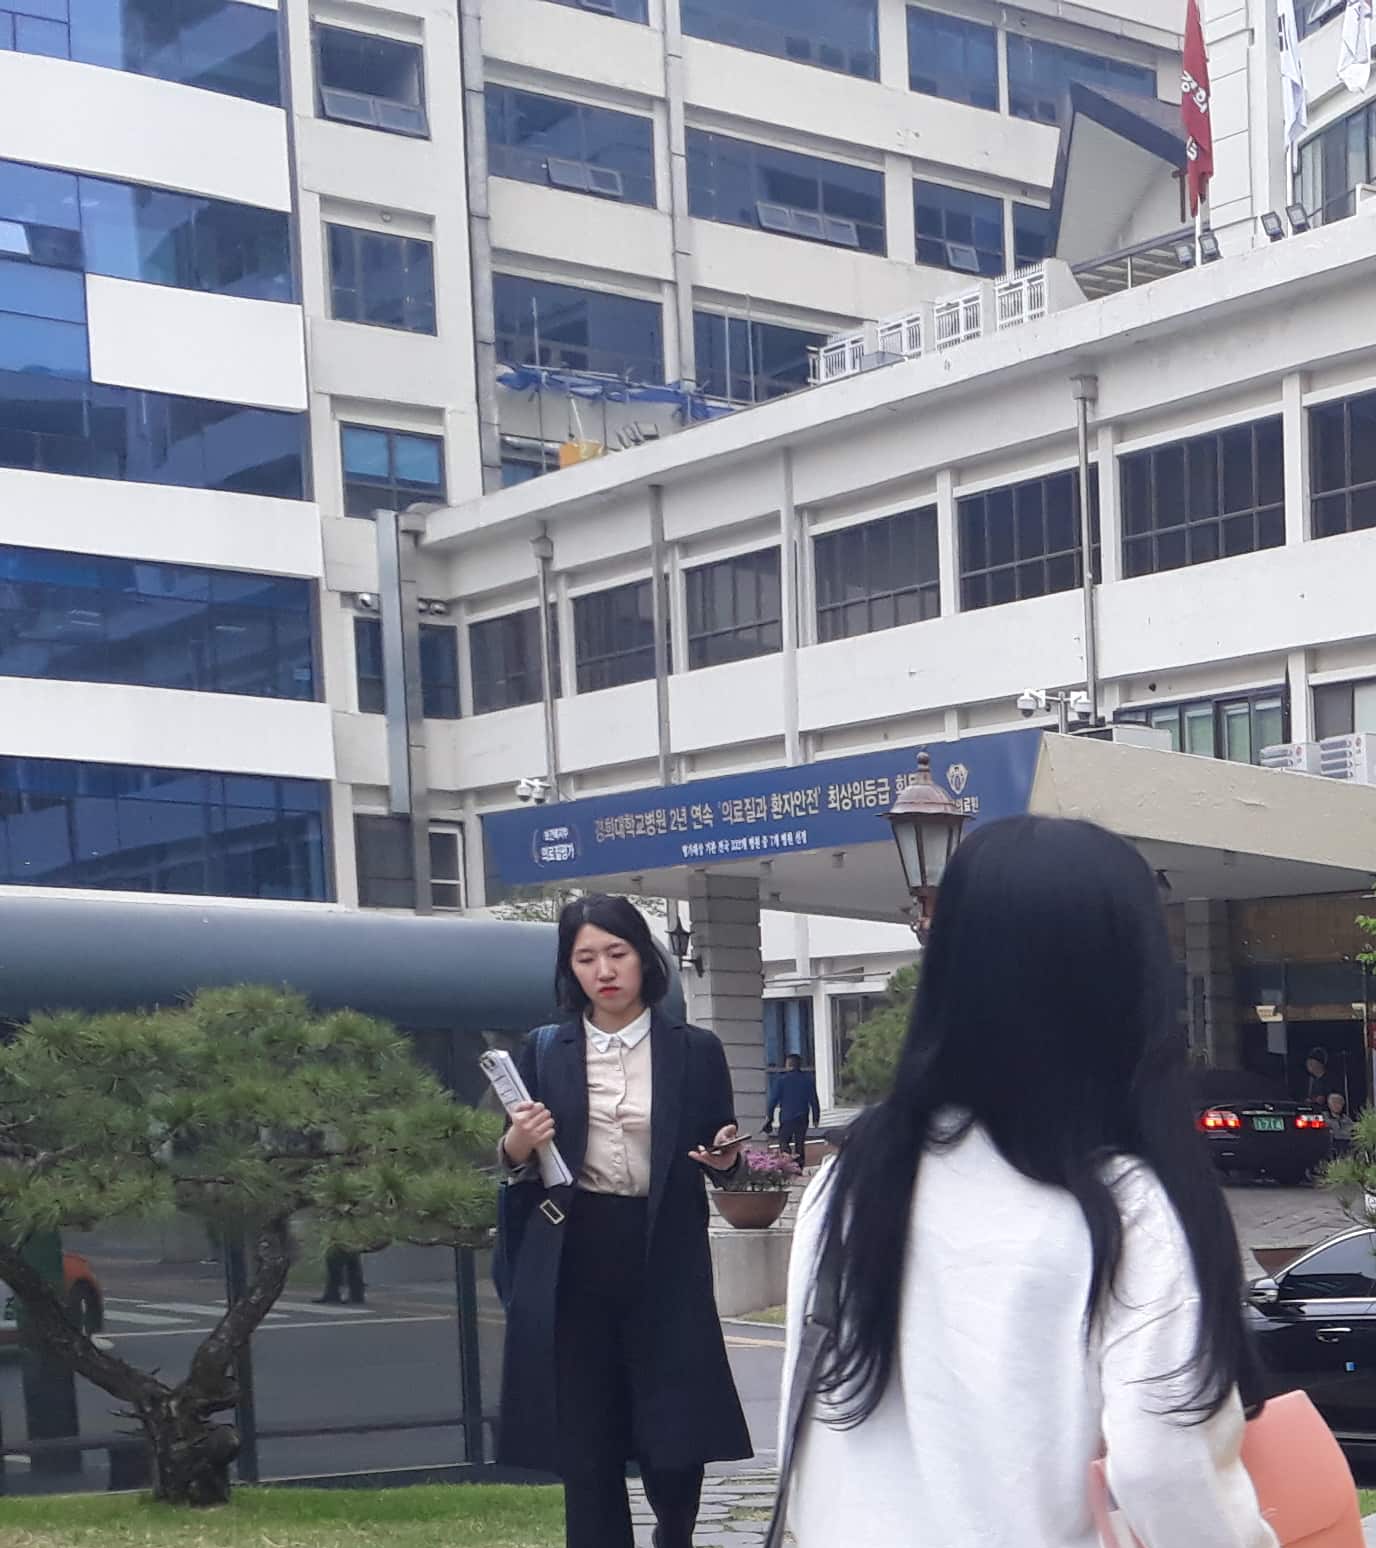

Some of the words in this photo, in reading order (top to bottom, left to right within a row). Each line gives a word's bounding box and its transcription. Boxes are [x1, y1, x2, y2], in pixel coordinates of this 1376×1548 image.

[594, 808, 667, 843] 경희대학교병원
[670, 806, 688, 831] 2년
[691, 803, 714, 830] 연속
[827, 777, 891, 812] 최상위등급
